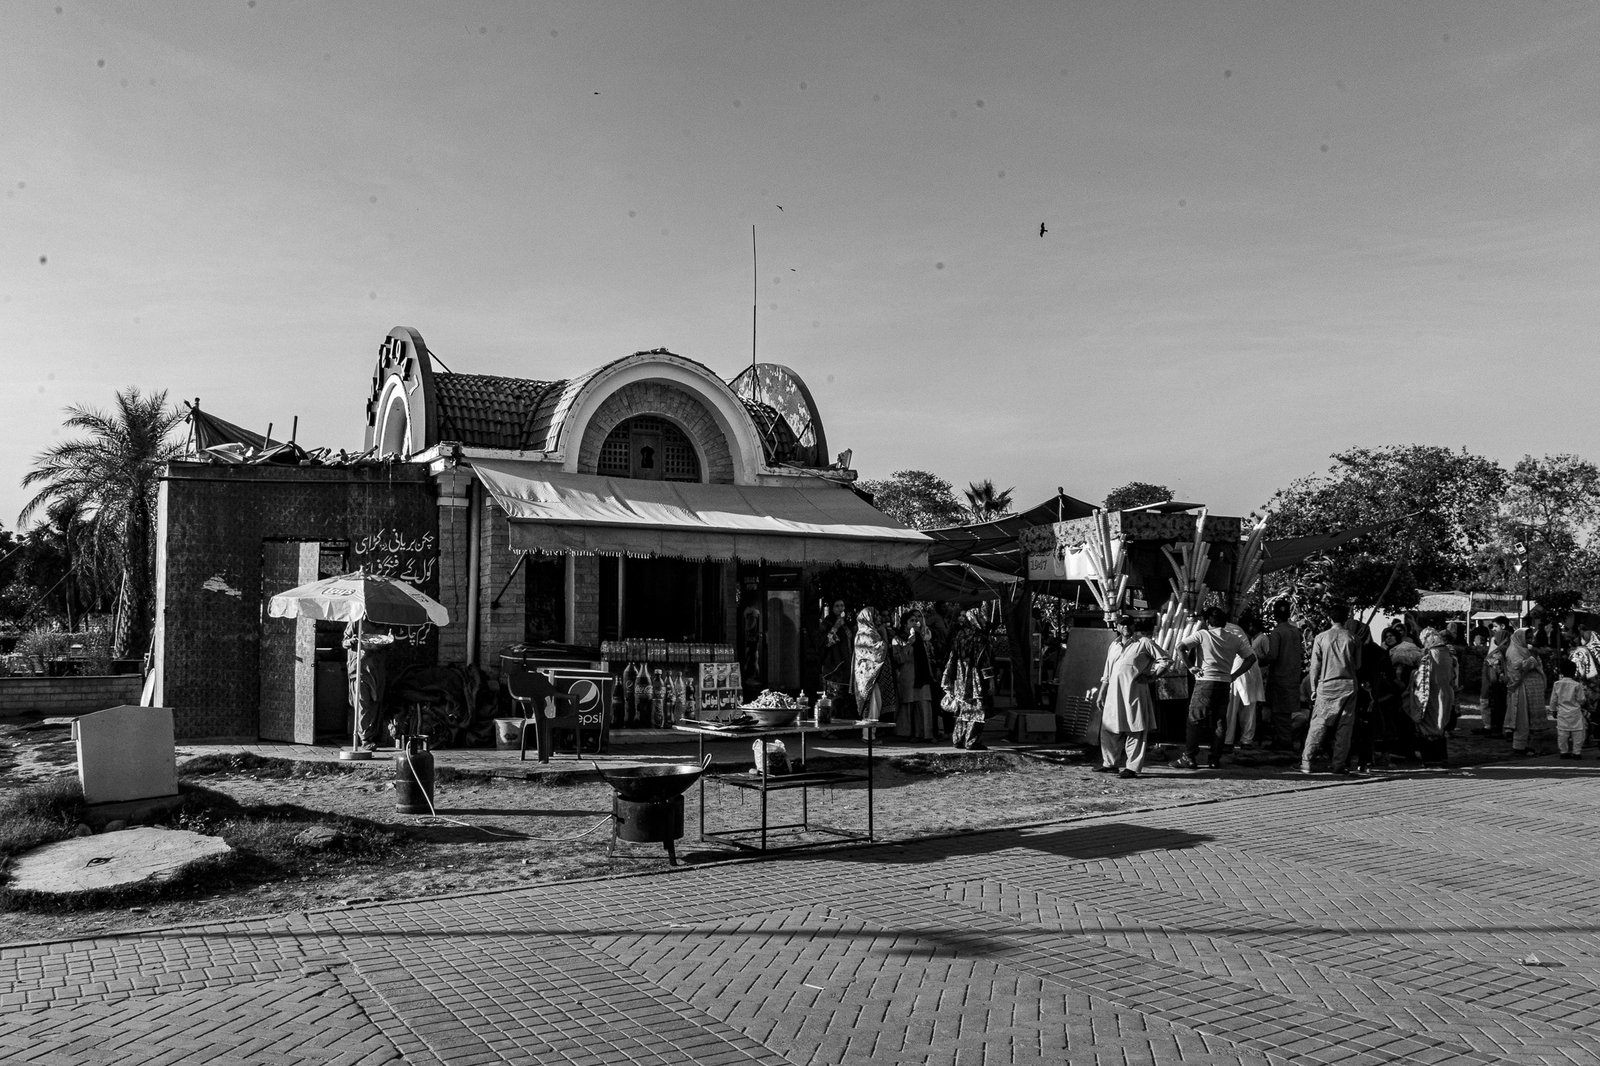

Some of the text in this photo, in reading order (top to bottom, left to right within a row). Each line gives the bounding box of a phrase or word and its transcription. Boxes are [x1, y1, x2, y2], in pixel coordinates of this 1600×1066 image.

[385, 336, 420, 396] 1947
[388, 528, 416, 553] بریانی
[413, 530, 436, 552] چکن
[414, 556, 437, 585] گول
